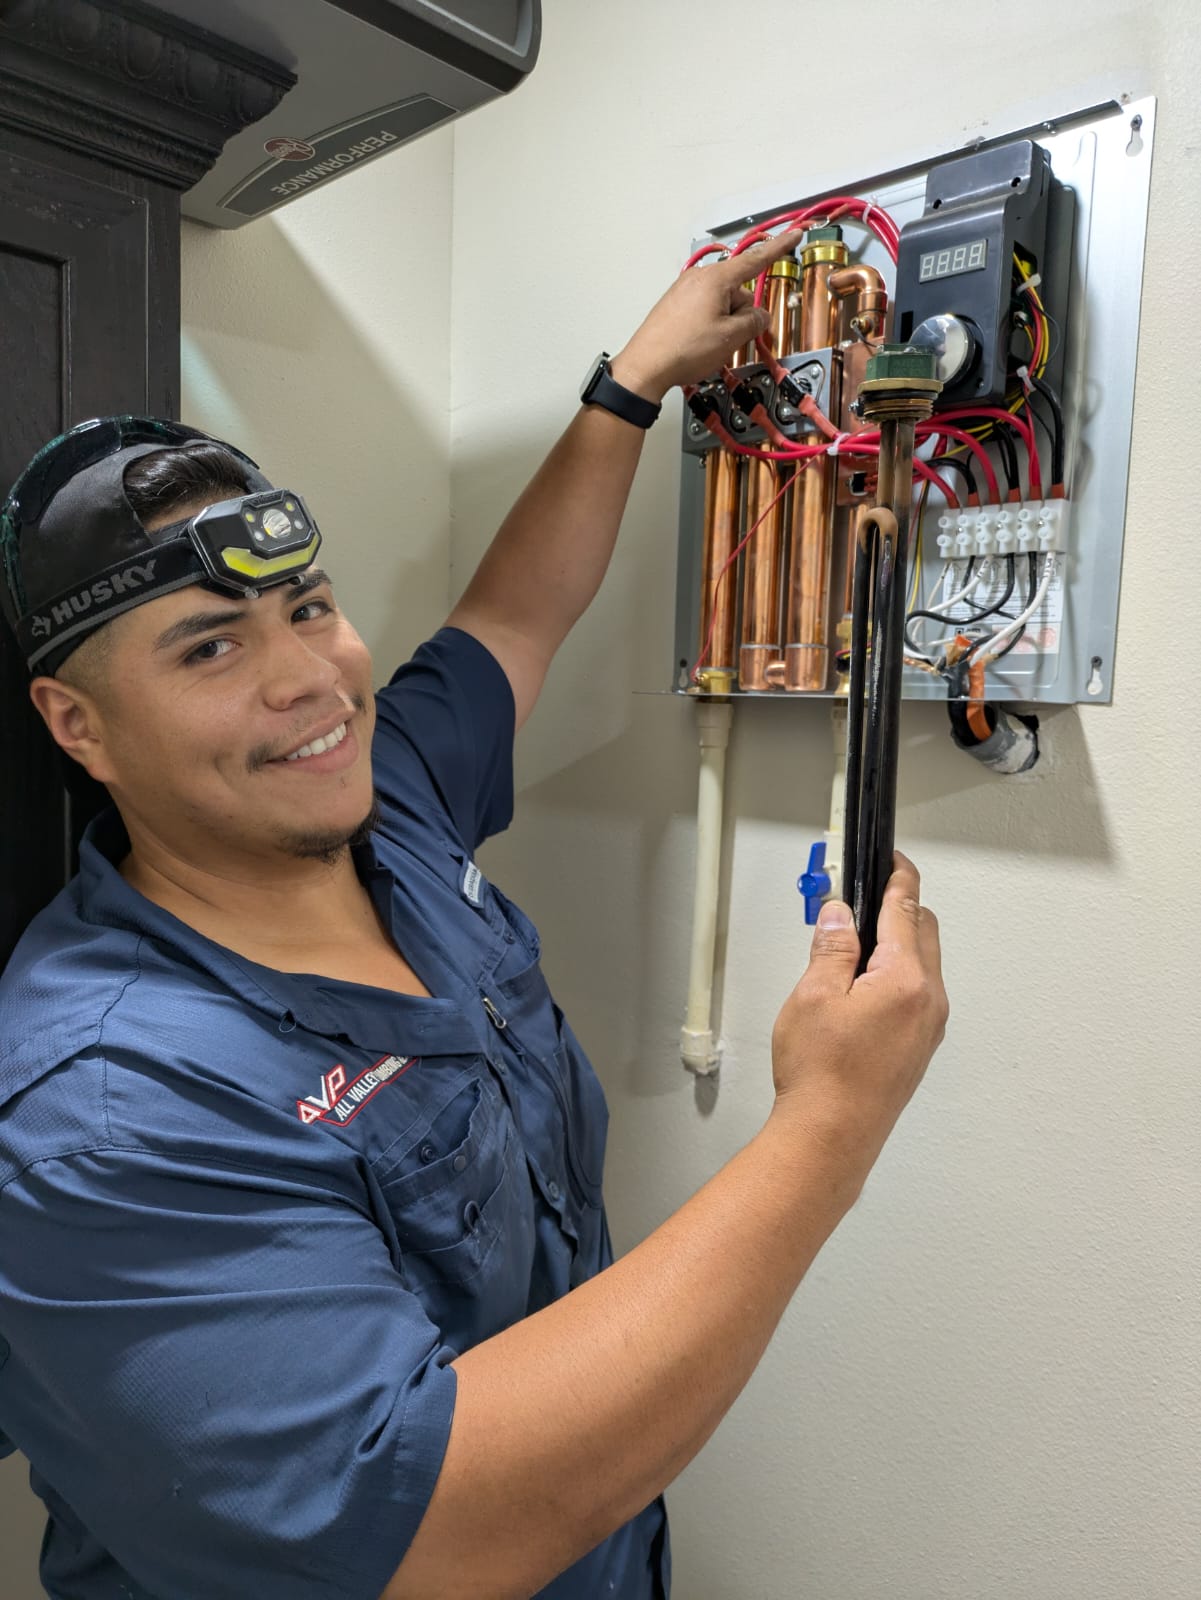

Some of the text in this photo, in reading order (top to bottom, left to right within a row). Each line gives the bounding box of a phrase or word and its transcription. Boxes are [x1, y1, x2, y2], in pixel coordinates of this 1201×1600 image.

[270, 130, 399, 196] PERFORMANCE
[51, 559, 156, 625] HUSKY
[297, 1064, 346, 1124] AVP
[334, 1099, 356, 1121] ALL
